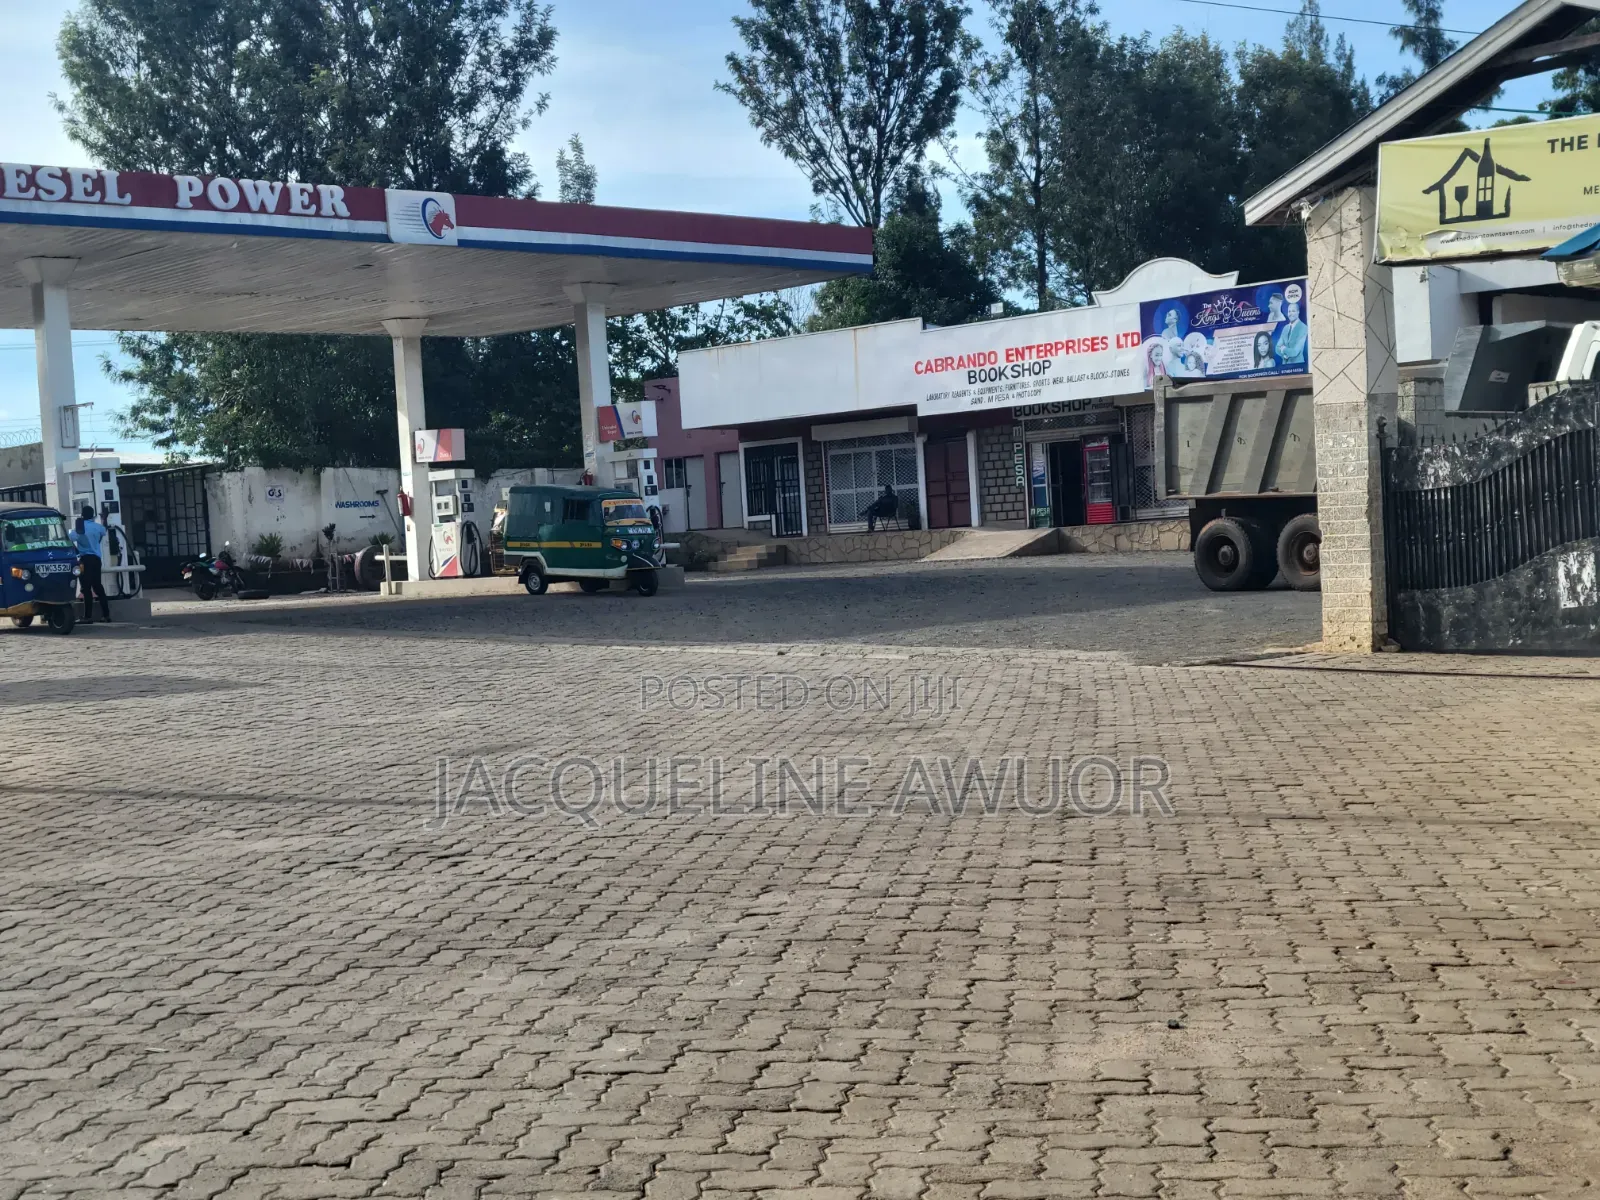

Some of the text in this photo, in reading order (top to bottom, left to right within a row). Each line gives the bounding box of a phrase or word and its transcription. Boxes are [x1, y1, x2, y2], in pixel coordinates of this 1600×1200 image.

[1547, 134, 1588, 154] THE
[173, 174, 351, 217] POWER
[1584, 185, 1600, 195] ME
[1191, 310, 1220, 327] Kings
[1233, 306, 1261, 323] Queens
[914, 331, 1141, 375] CABRANDO ENTERPRISES LTD
[967, 359, 1052, 385] BOOKSHOP
[1033, 378, 1050, 388] SPORTS
[994, 393, 1010, 402] PESA
[1014, 398, 1091, 417] BOOKSHOP
[1013, 442, 1025, 487] PESA
[335, 500, 380, 508] WASHROOMS
